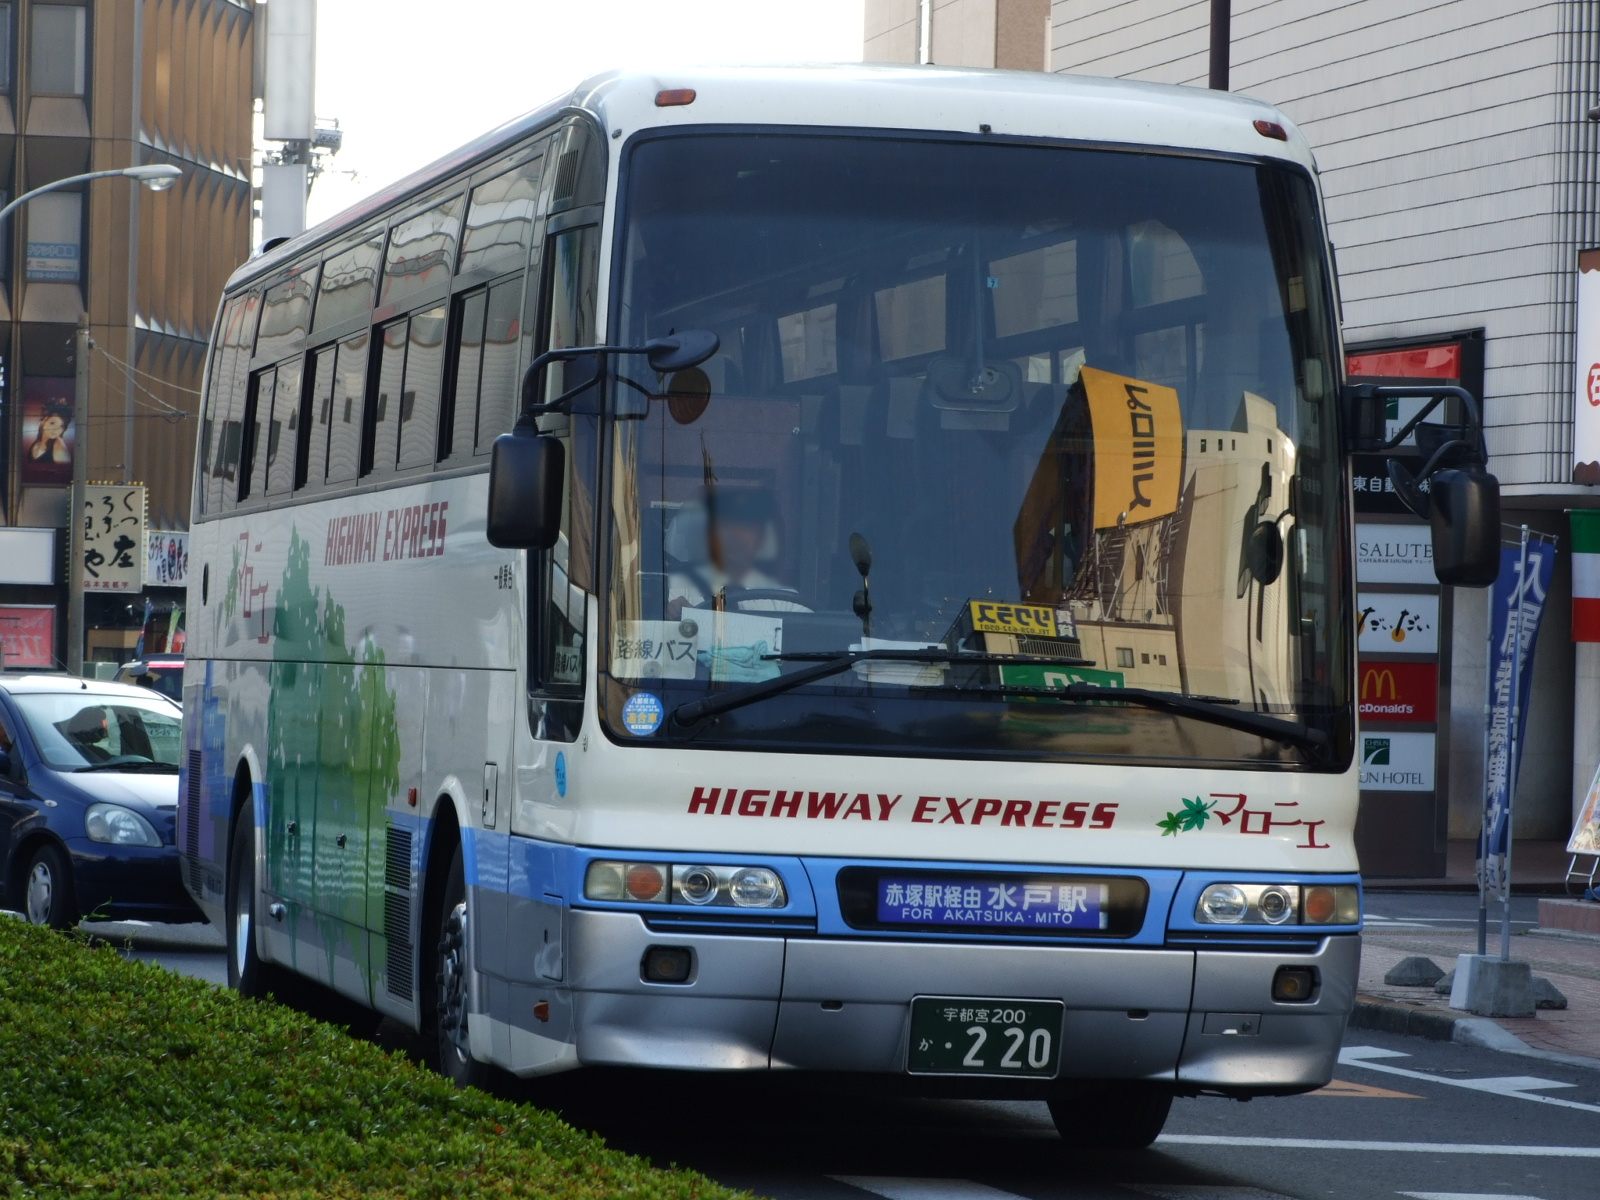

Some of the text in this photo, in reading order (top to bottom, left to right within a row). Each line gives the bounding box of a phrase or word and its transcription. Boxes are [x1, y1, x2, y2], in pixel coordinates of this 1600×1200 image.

[325, 501, 449, 566] HIGHWAY EXPRESS
[1359, 542, 1433, 558] SALUTE
[617, 639, 696, 662] 路線バス
[1358, 703, 1414, 714] cDonald's
[1382, 772, 1425, 785] HOTEL
[688, 787, 1119, 831] HIGHWAY EXPRESS
[1209, 792, 1330, 849] マロニエ
[886, 883, 1087, 913] 赤塚駅経由 水戸駅
[902, 908, 933, 920] FOR
